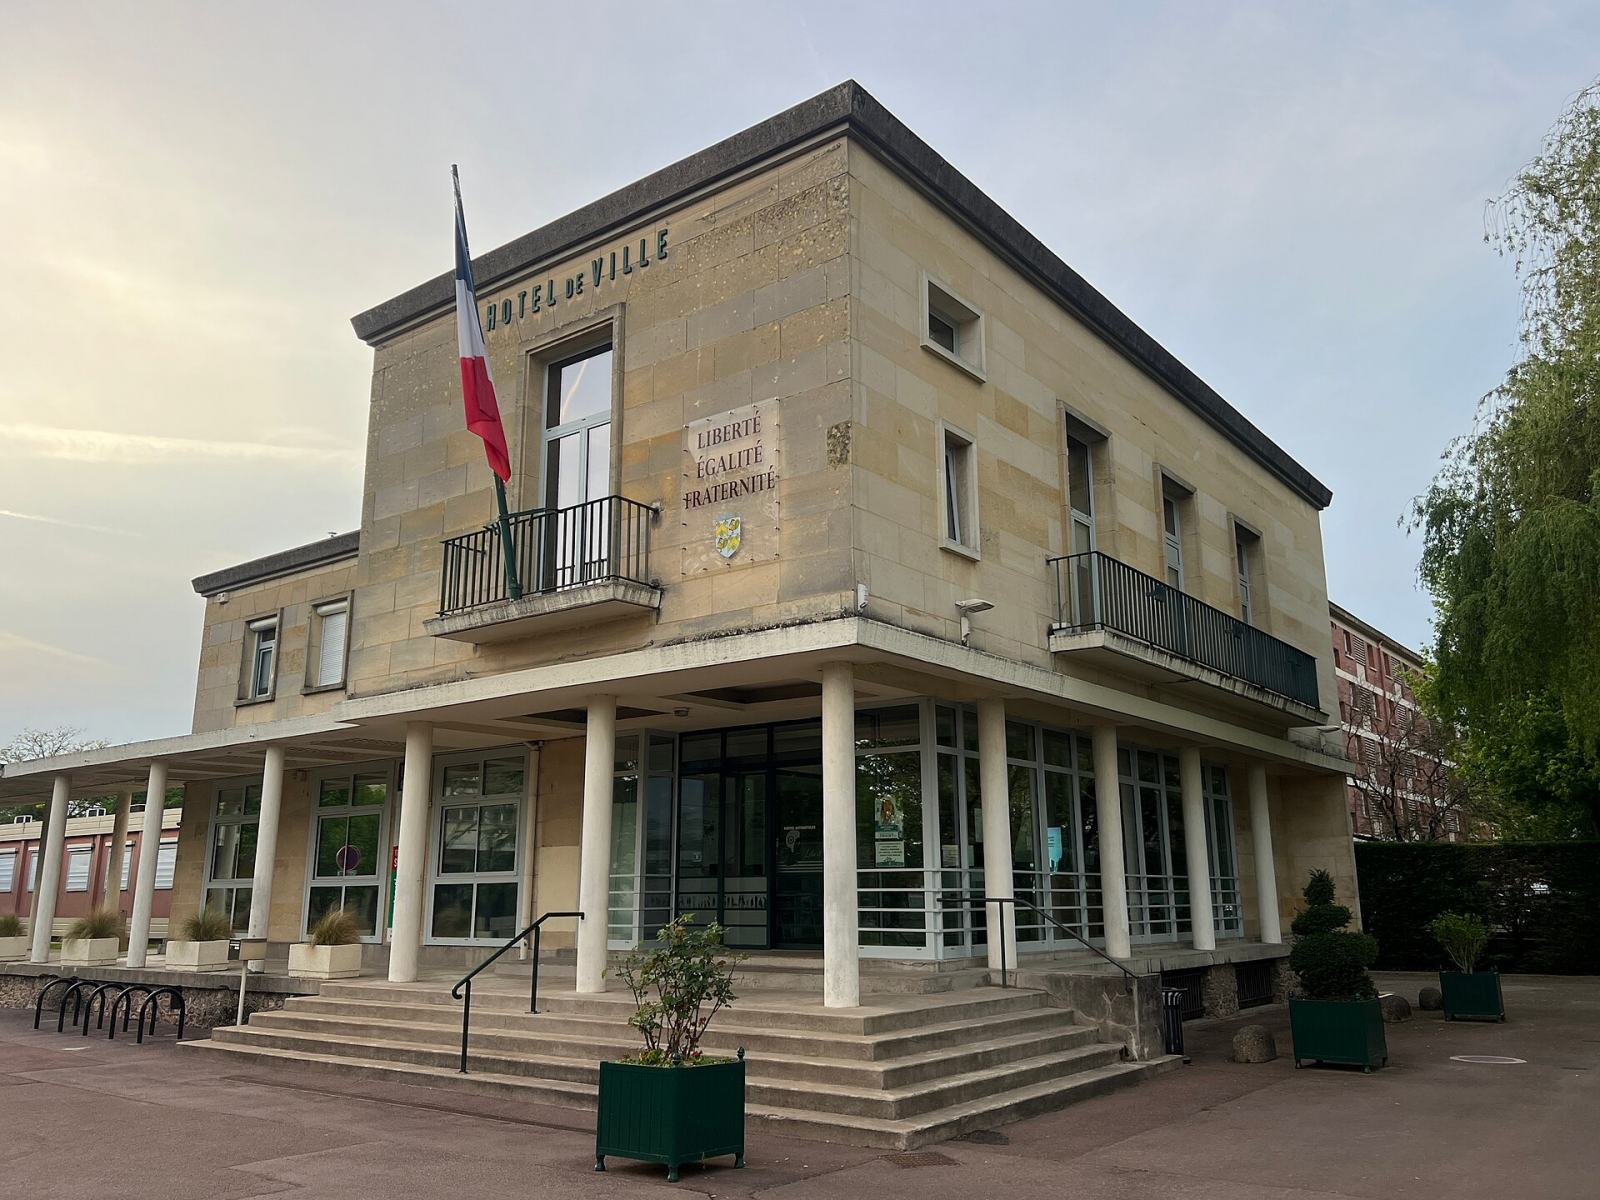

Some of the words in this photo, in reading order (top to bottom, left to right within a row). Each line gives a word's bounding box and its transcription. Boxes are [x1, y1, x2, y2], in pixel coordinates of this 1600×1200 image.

[486, 279, 556, 332] HOTEL
[565, 272, 584, 299] DE
[591, 228, 668, 287] VILLE
[697, 410, 761, 450] LIBERTÉ
[696, 439, 763, 479] ÉGALITÉ
[684, 465, 776, 510] FRATERNITÉ
